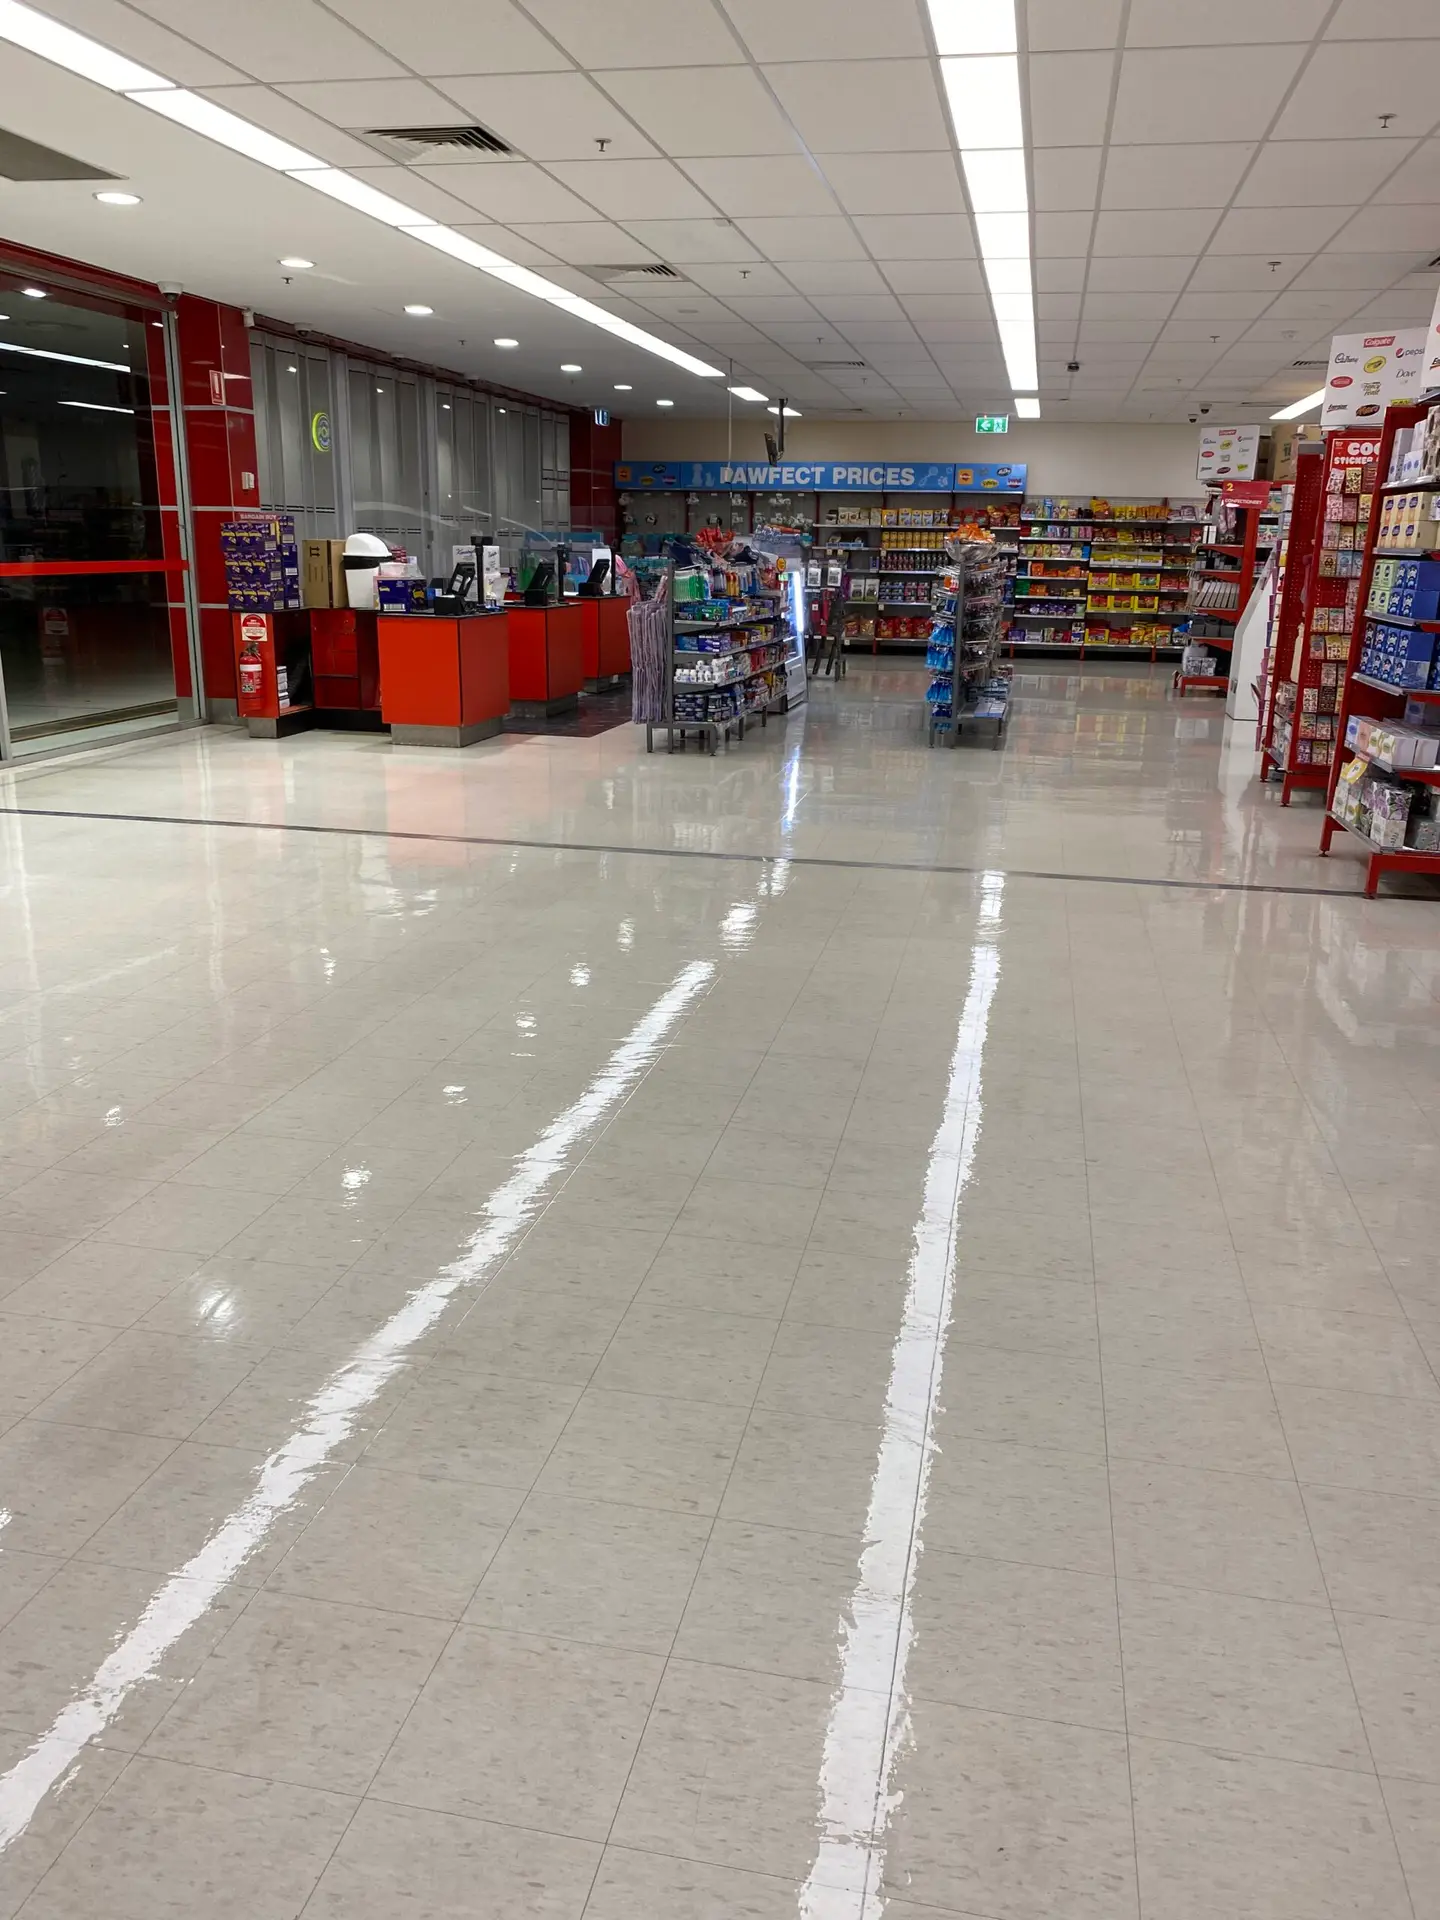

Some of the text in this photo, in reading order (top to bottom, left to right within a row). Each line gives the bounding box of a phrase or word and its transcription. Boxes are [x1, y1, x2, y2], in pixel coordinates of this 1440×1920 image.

[1364, 337, 1392, 347] Colgate
[1405, 348, 1425, 356] pepsi
[1396, 368, 1416, 378] Dove
[832, 466, 915, 486] PRICES
[1226, 483, 1234, 492] 2
